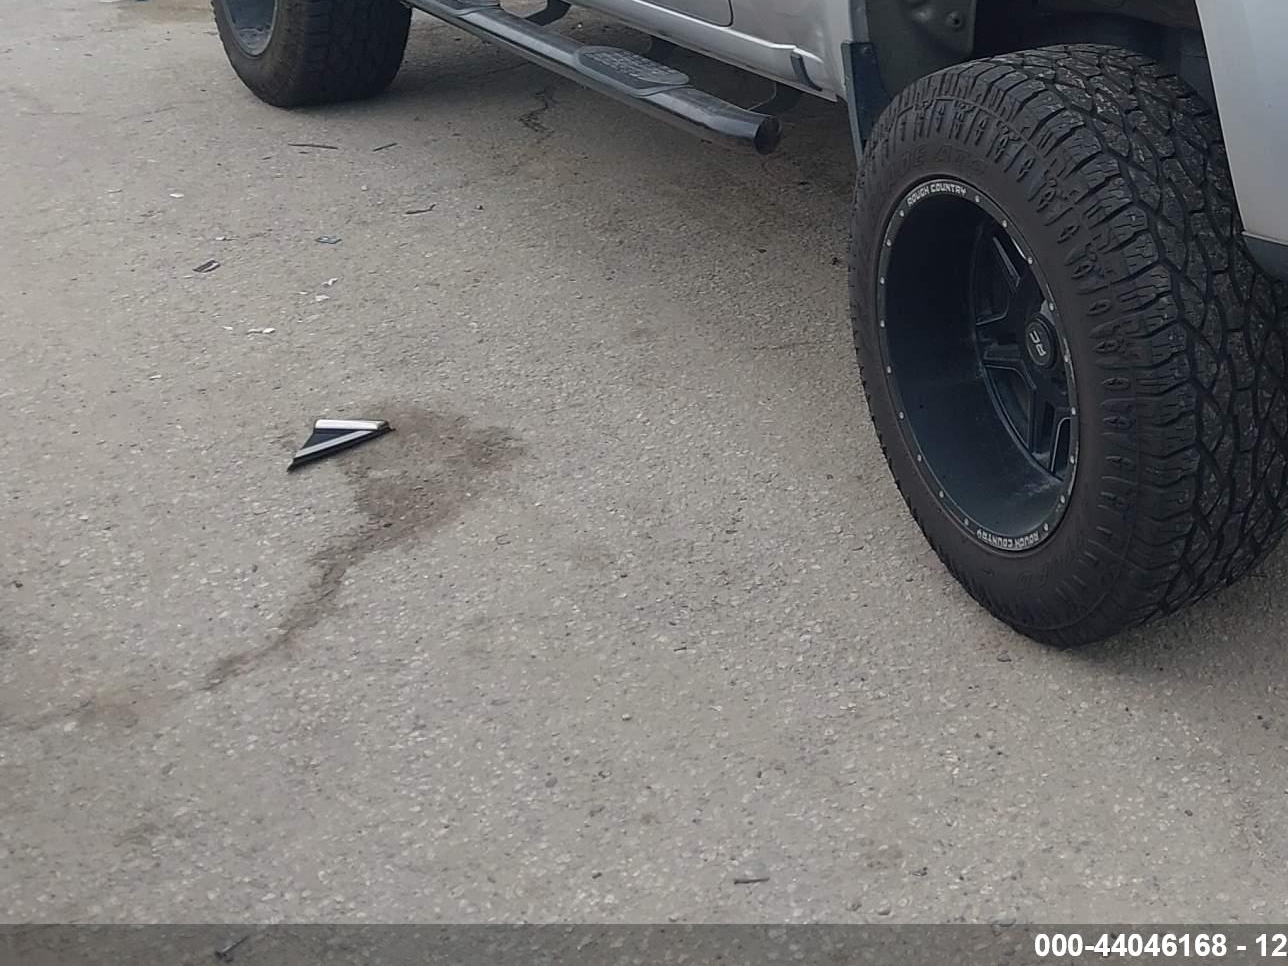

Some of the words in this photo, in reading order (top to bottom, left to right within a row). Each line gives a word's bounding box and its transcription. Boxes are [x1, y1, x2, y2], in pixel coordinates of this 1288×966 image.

[906, 186, 930, 208] ROUGH
[930, 183, 968, 197] COUNTRY
[976, 529, 1013, 548] COUNTRY
[1014, 530, 1039, 549] ROUGH
